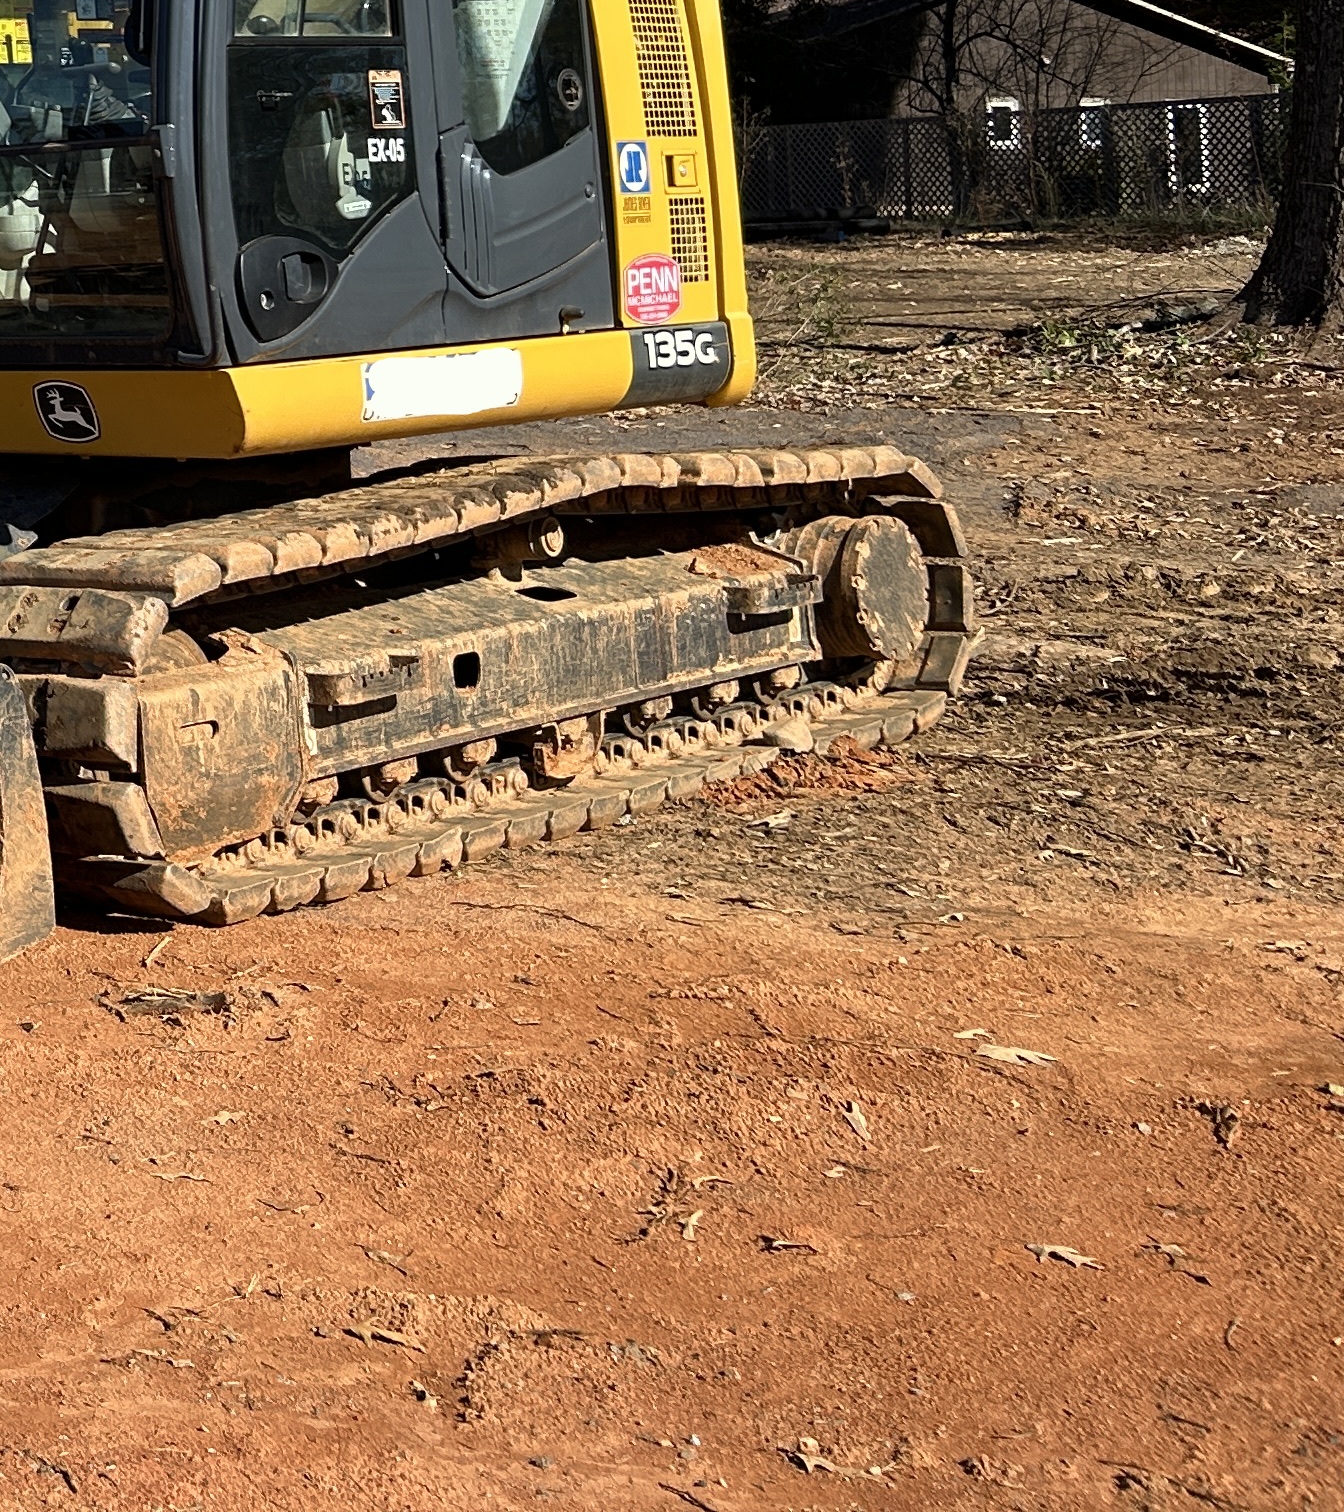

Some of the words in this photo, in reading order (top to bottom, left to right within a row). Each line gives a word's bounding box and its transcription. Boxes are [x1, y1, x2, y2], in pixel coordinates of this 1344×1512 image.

[367, 138, 405, 162] EX-05
[627, 265, 678, 296] PENN
[643, 330, 719, 369] 135G
